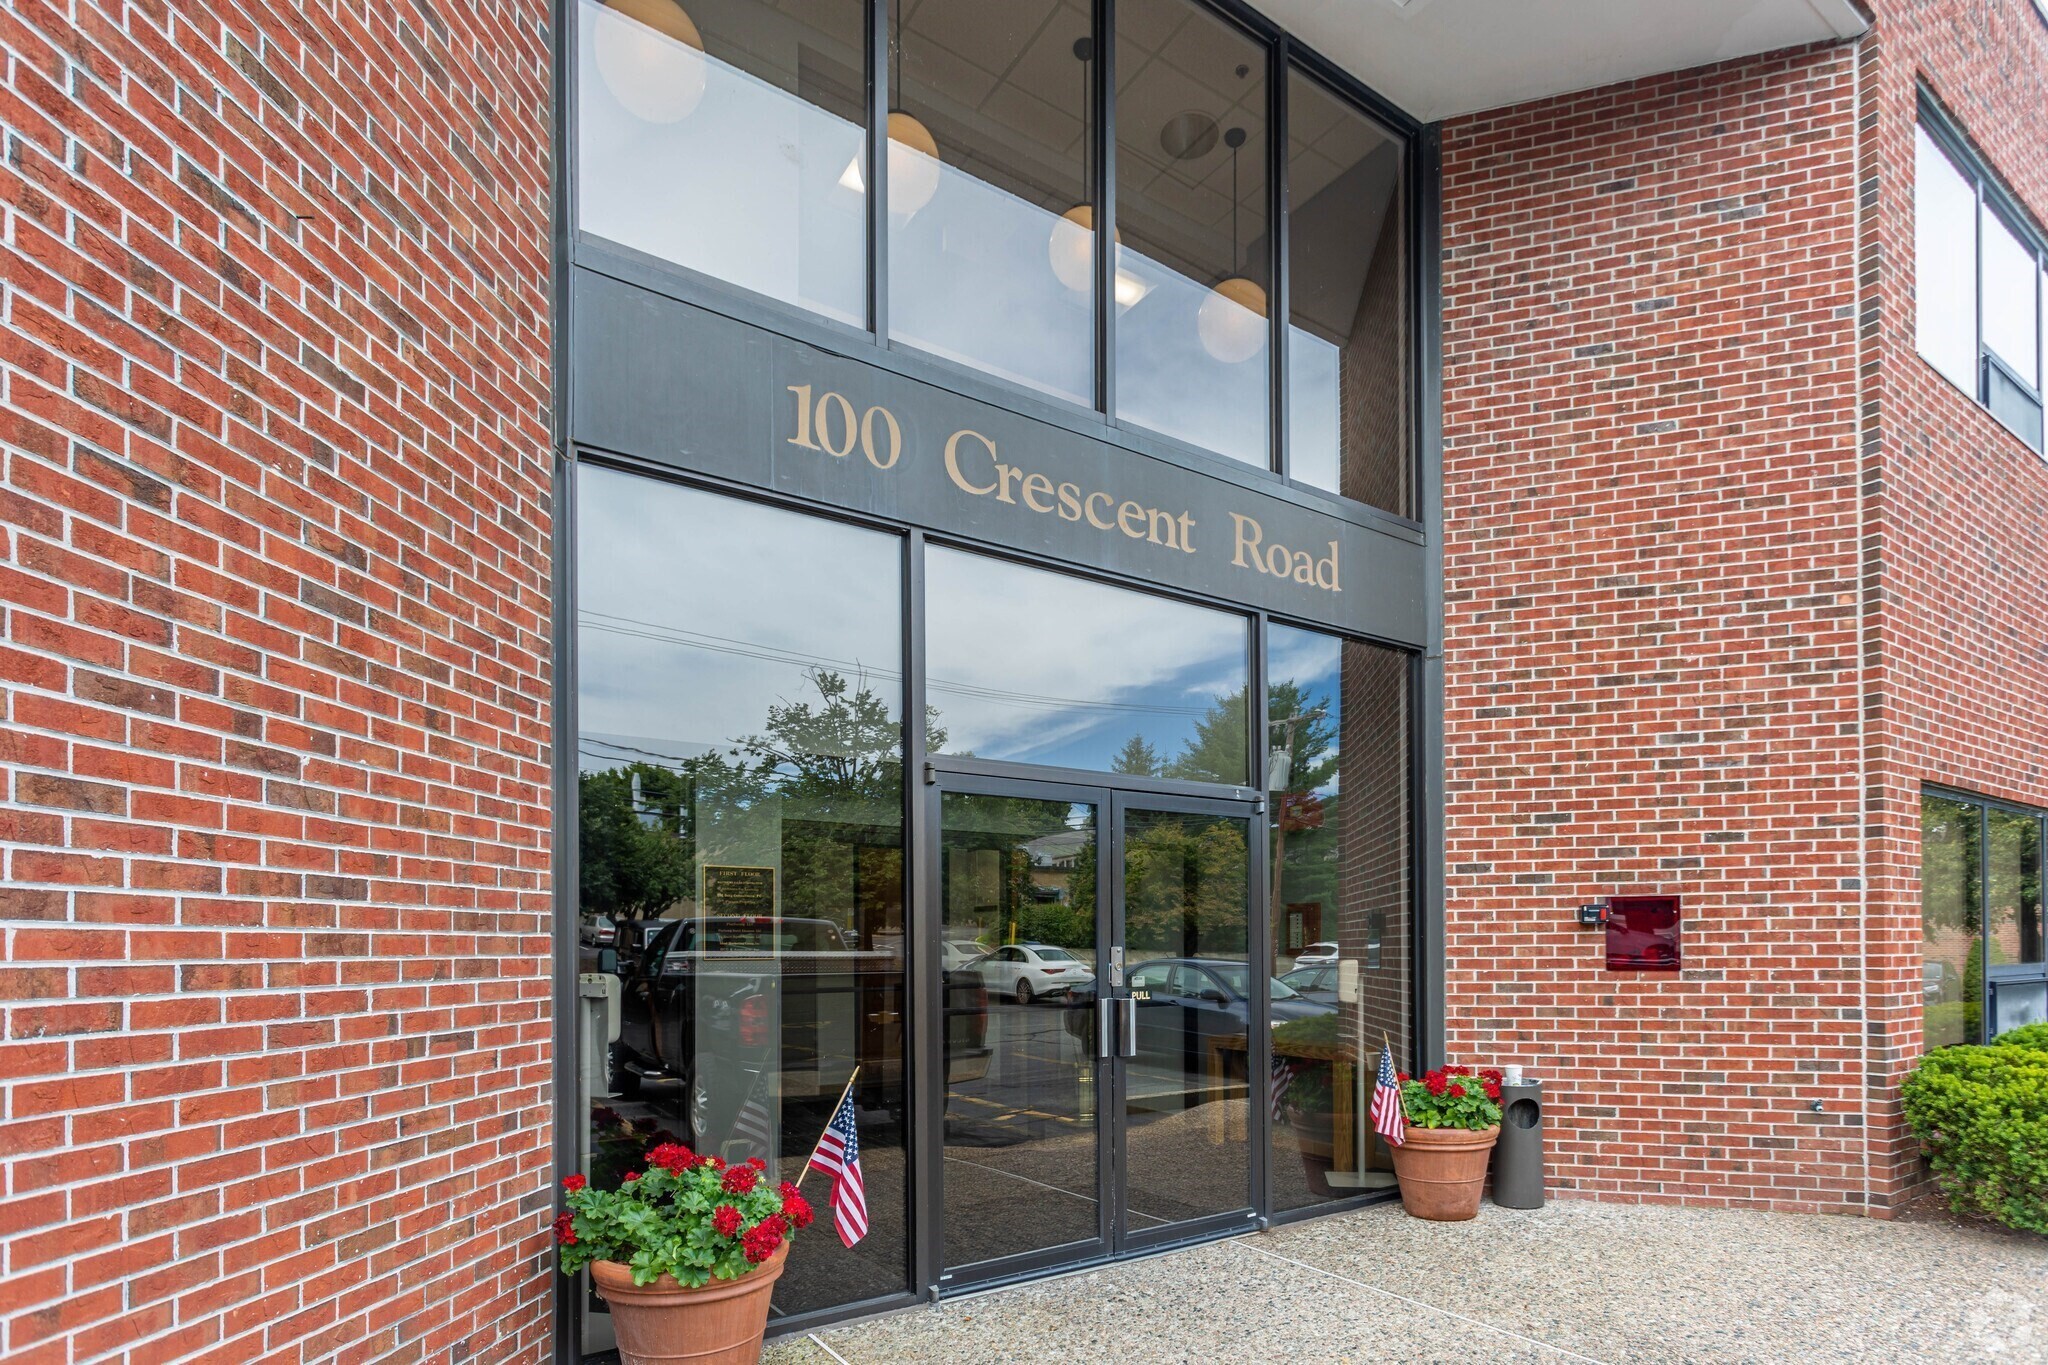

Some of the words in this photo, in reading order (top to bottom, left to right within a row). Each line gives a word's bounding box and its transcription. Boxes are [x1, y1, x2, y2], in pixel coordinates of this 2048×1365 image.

[788, 385, 901, 469] 100
[944, 430, 1197, 553] Crescent
[1228, 511, 1342, 592] Road
[1131, 990, 1151, 1000] PULL
